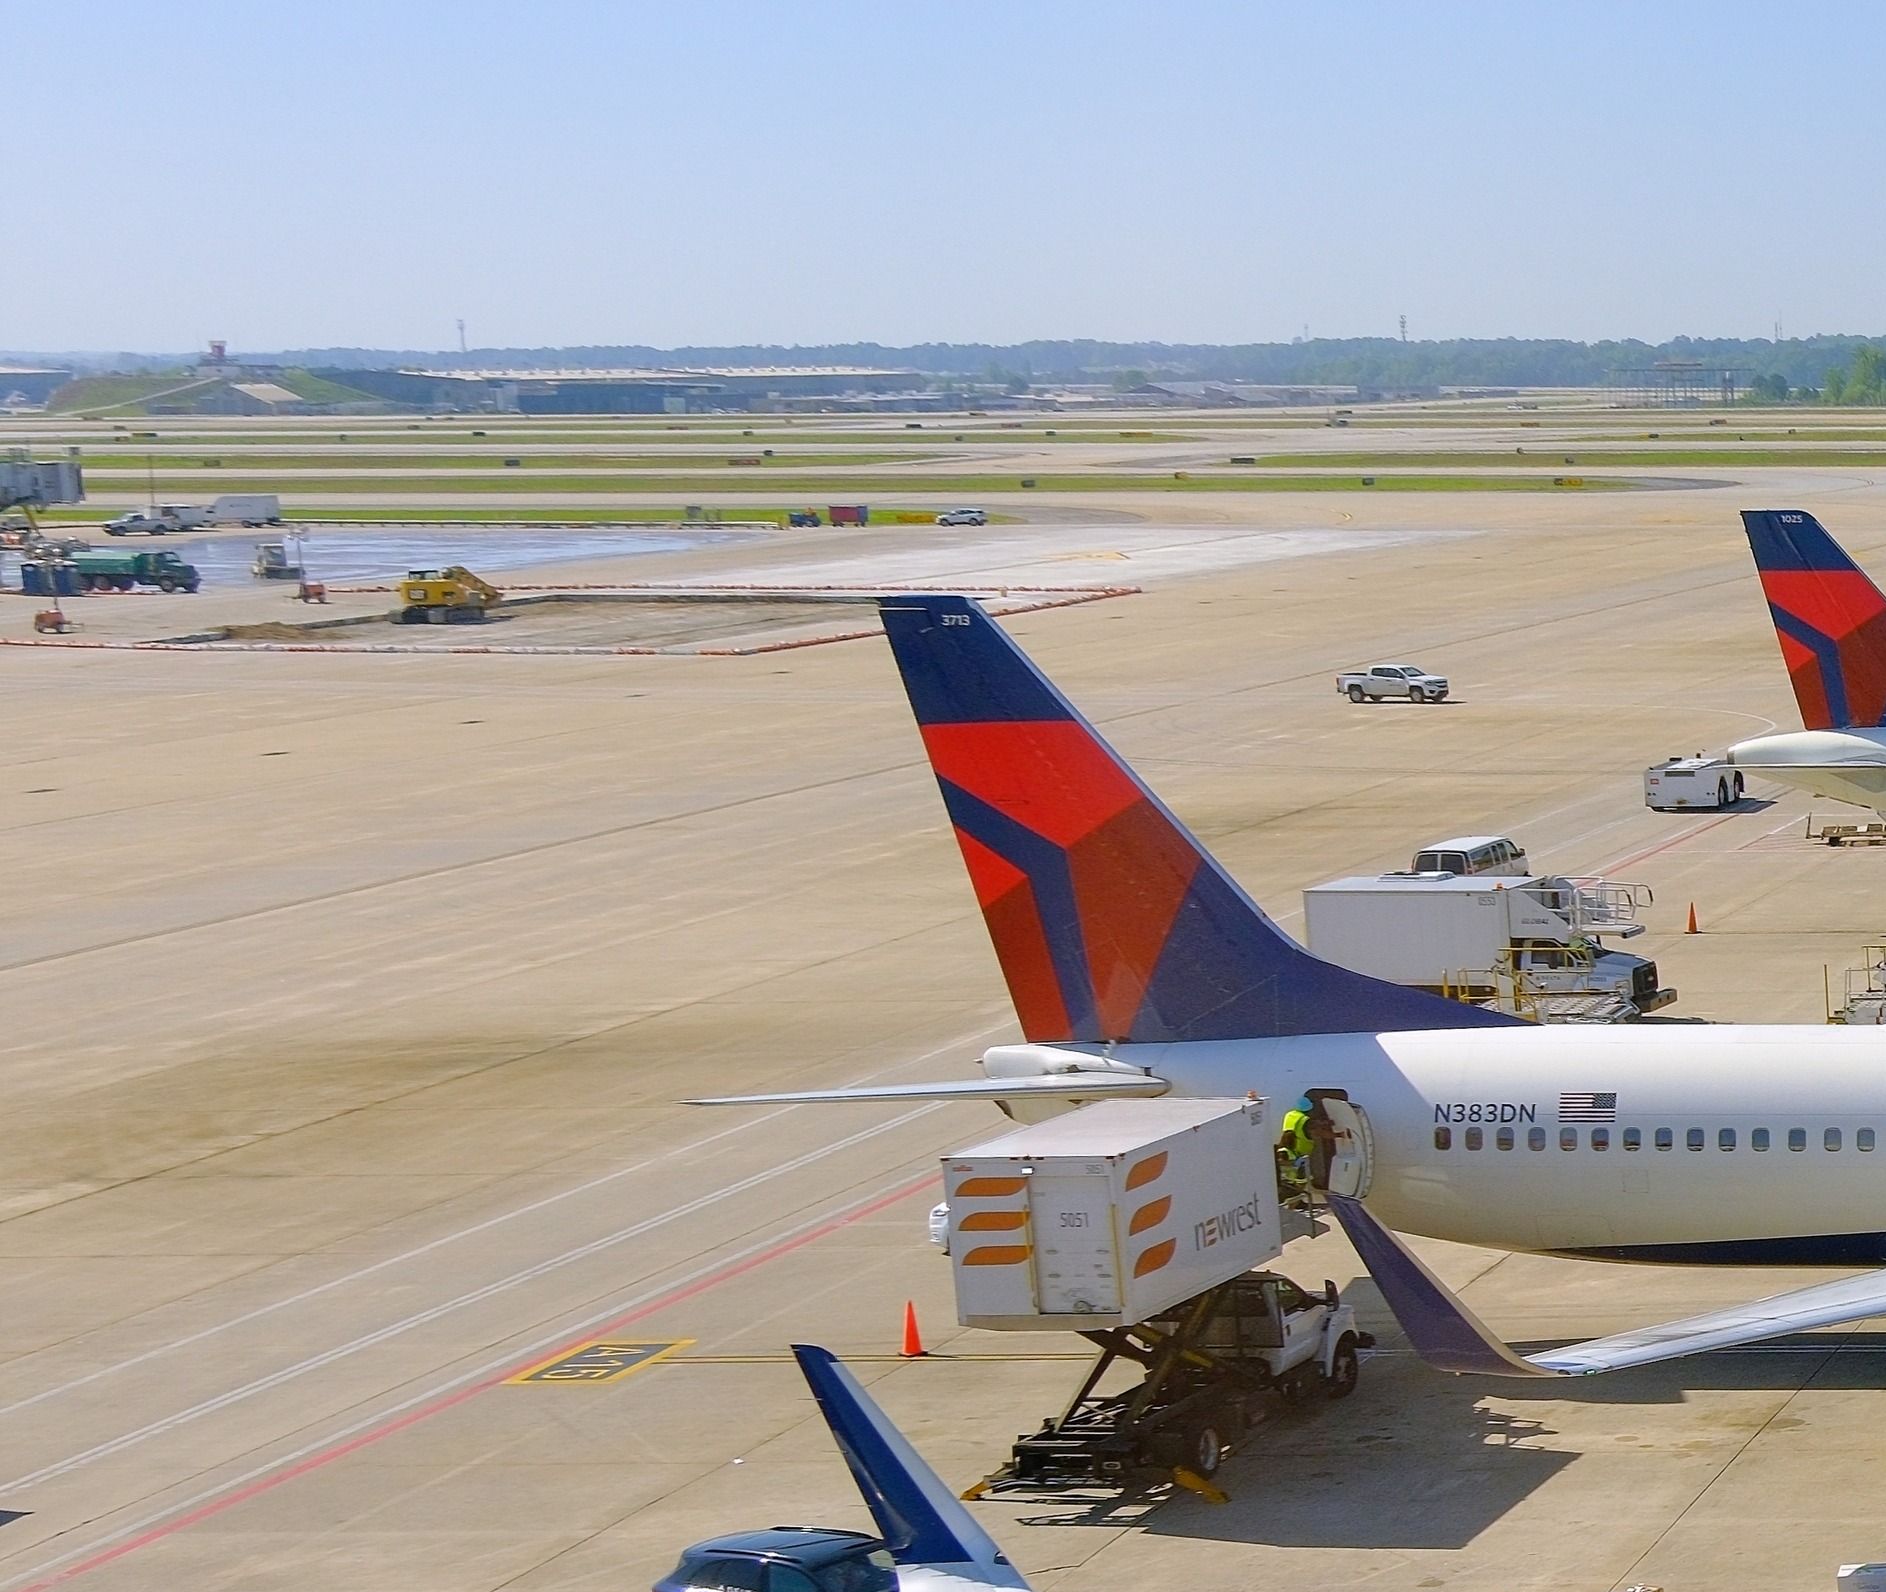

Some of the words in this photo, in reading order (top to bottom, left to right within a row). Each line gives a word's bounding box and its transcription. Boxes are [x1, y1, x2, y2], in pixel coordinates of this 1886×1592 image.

[1781, 515, 1803, 523] 1025
[941, 614, 970, 626] 3713
[1434, 1103, 1537, 1122] N383DN
[1060, 1211, 1085, 1228] 5051
[1193, 1191, 1263, 1252] newrest
[541, 1346, 644, 1380] A15
